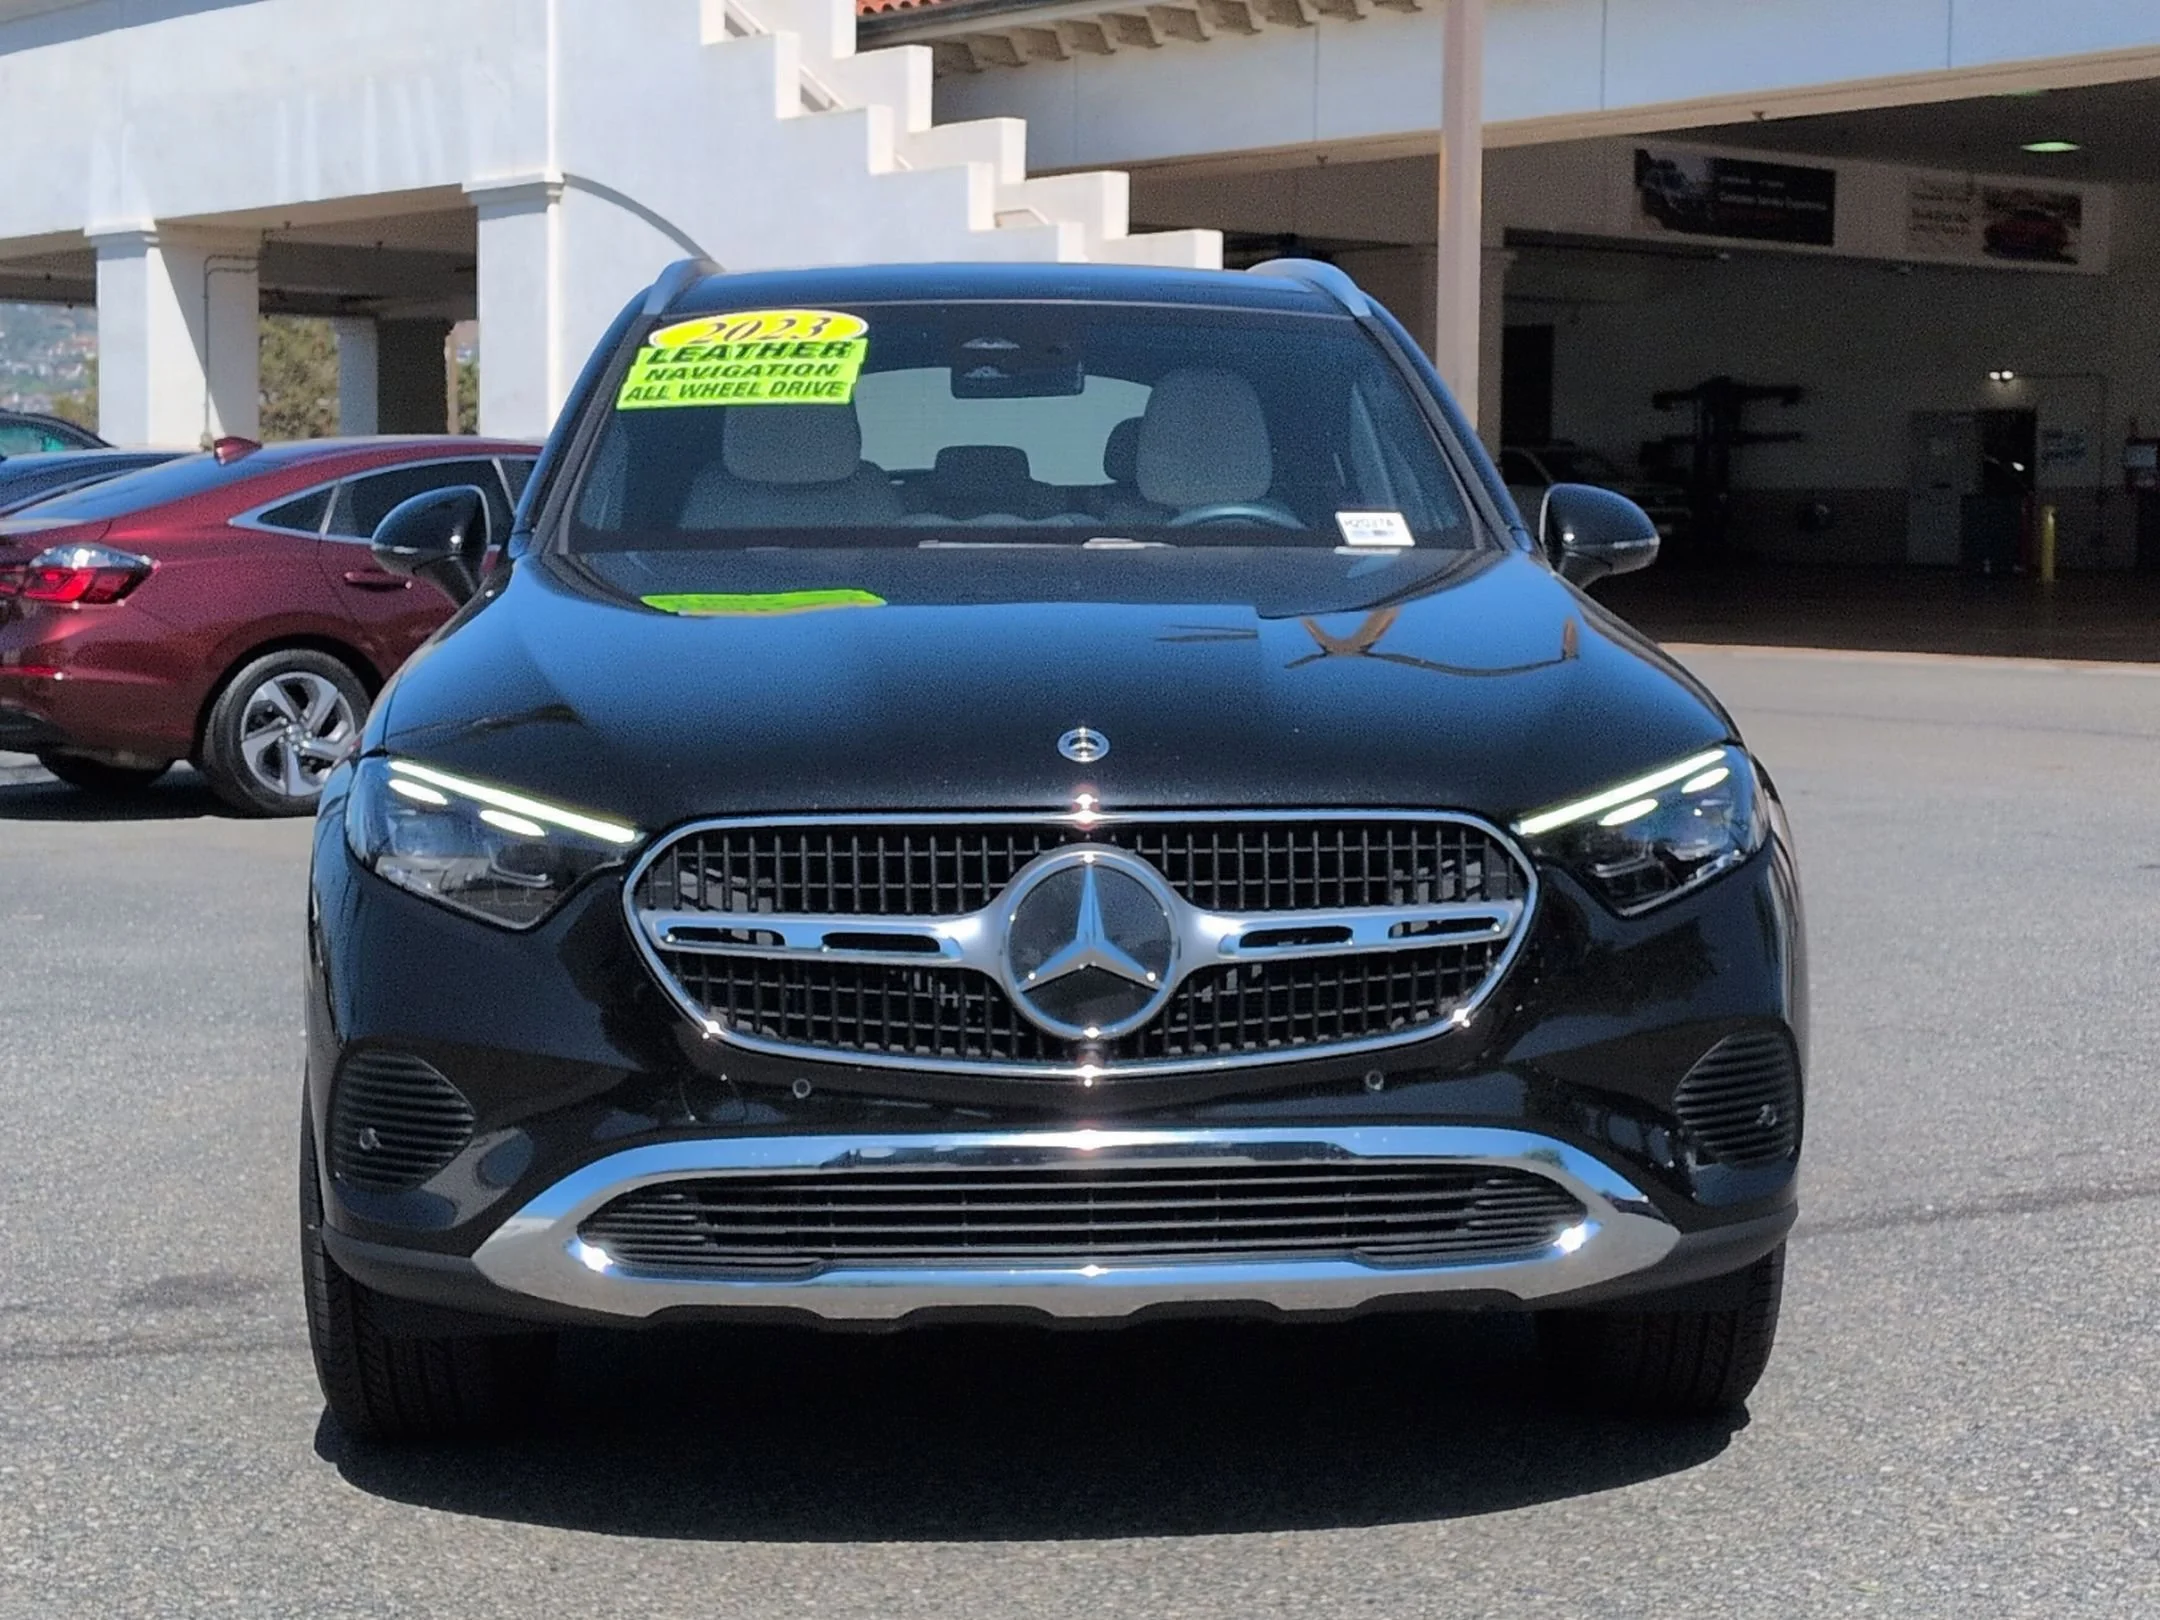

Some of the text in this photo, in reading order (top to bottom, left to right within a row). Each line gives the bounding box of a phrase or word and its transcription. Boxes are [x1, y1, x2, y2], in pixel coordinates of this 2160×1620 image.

[688, 316, 832, 343] 2023
[647, 341, 849, 365] LEATHER
[643, 362, 840, 382] NAVIGATION
[624, 379, 848, 401] ALL WHEEL DRIVE
